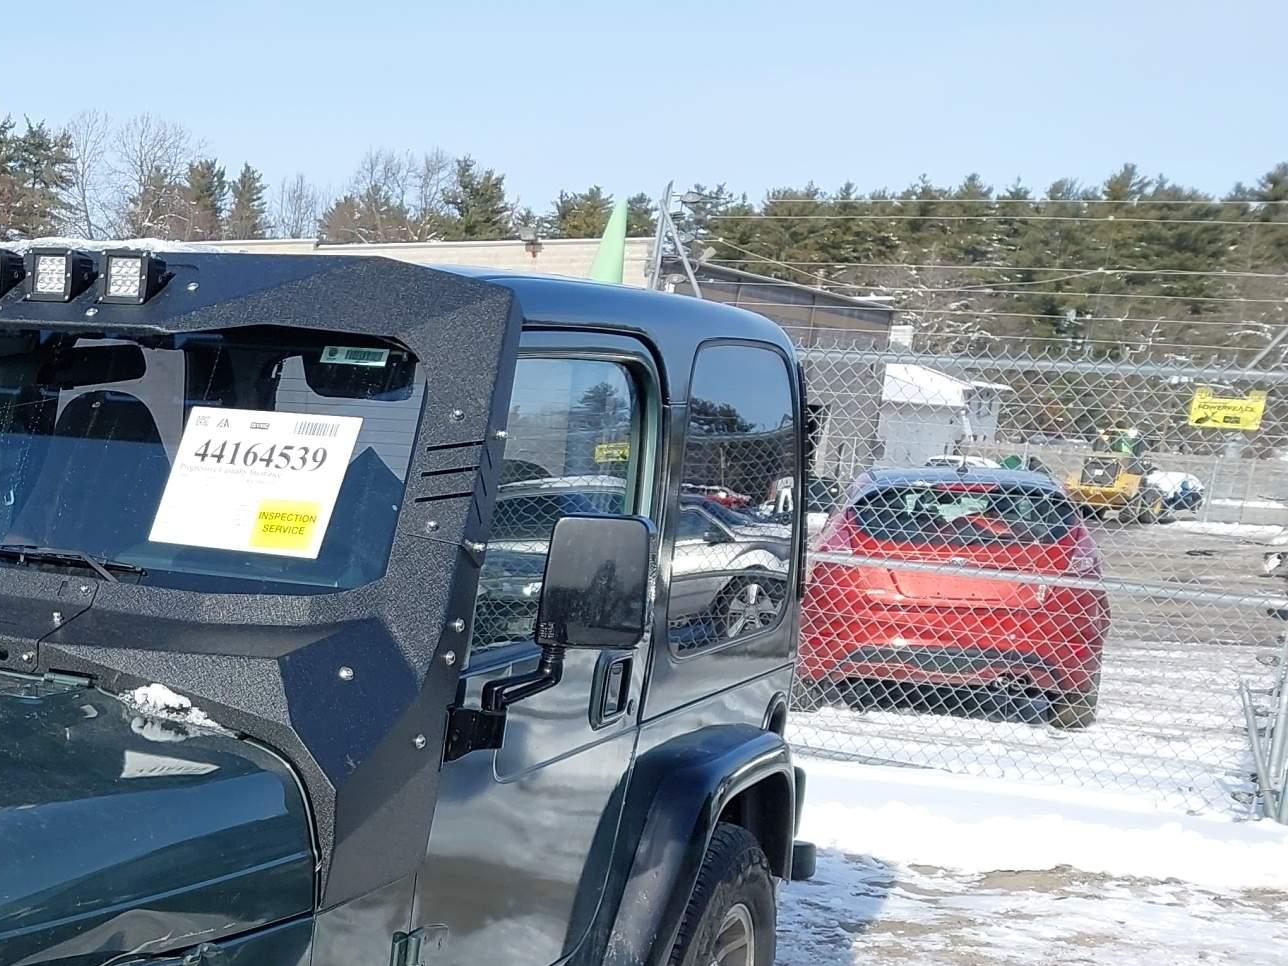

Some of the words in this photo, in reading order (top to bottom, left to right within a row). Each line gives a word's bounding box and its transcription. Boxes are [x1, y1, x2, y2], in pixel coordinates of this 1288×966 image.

[194, 439, 328, 472] 44164539
[258, 511, 318, 524] INSPECTION
[262, 524, 306, 535] SERVICE
